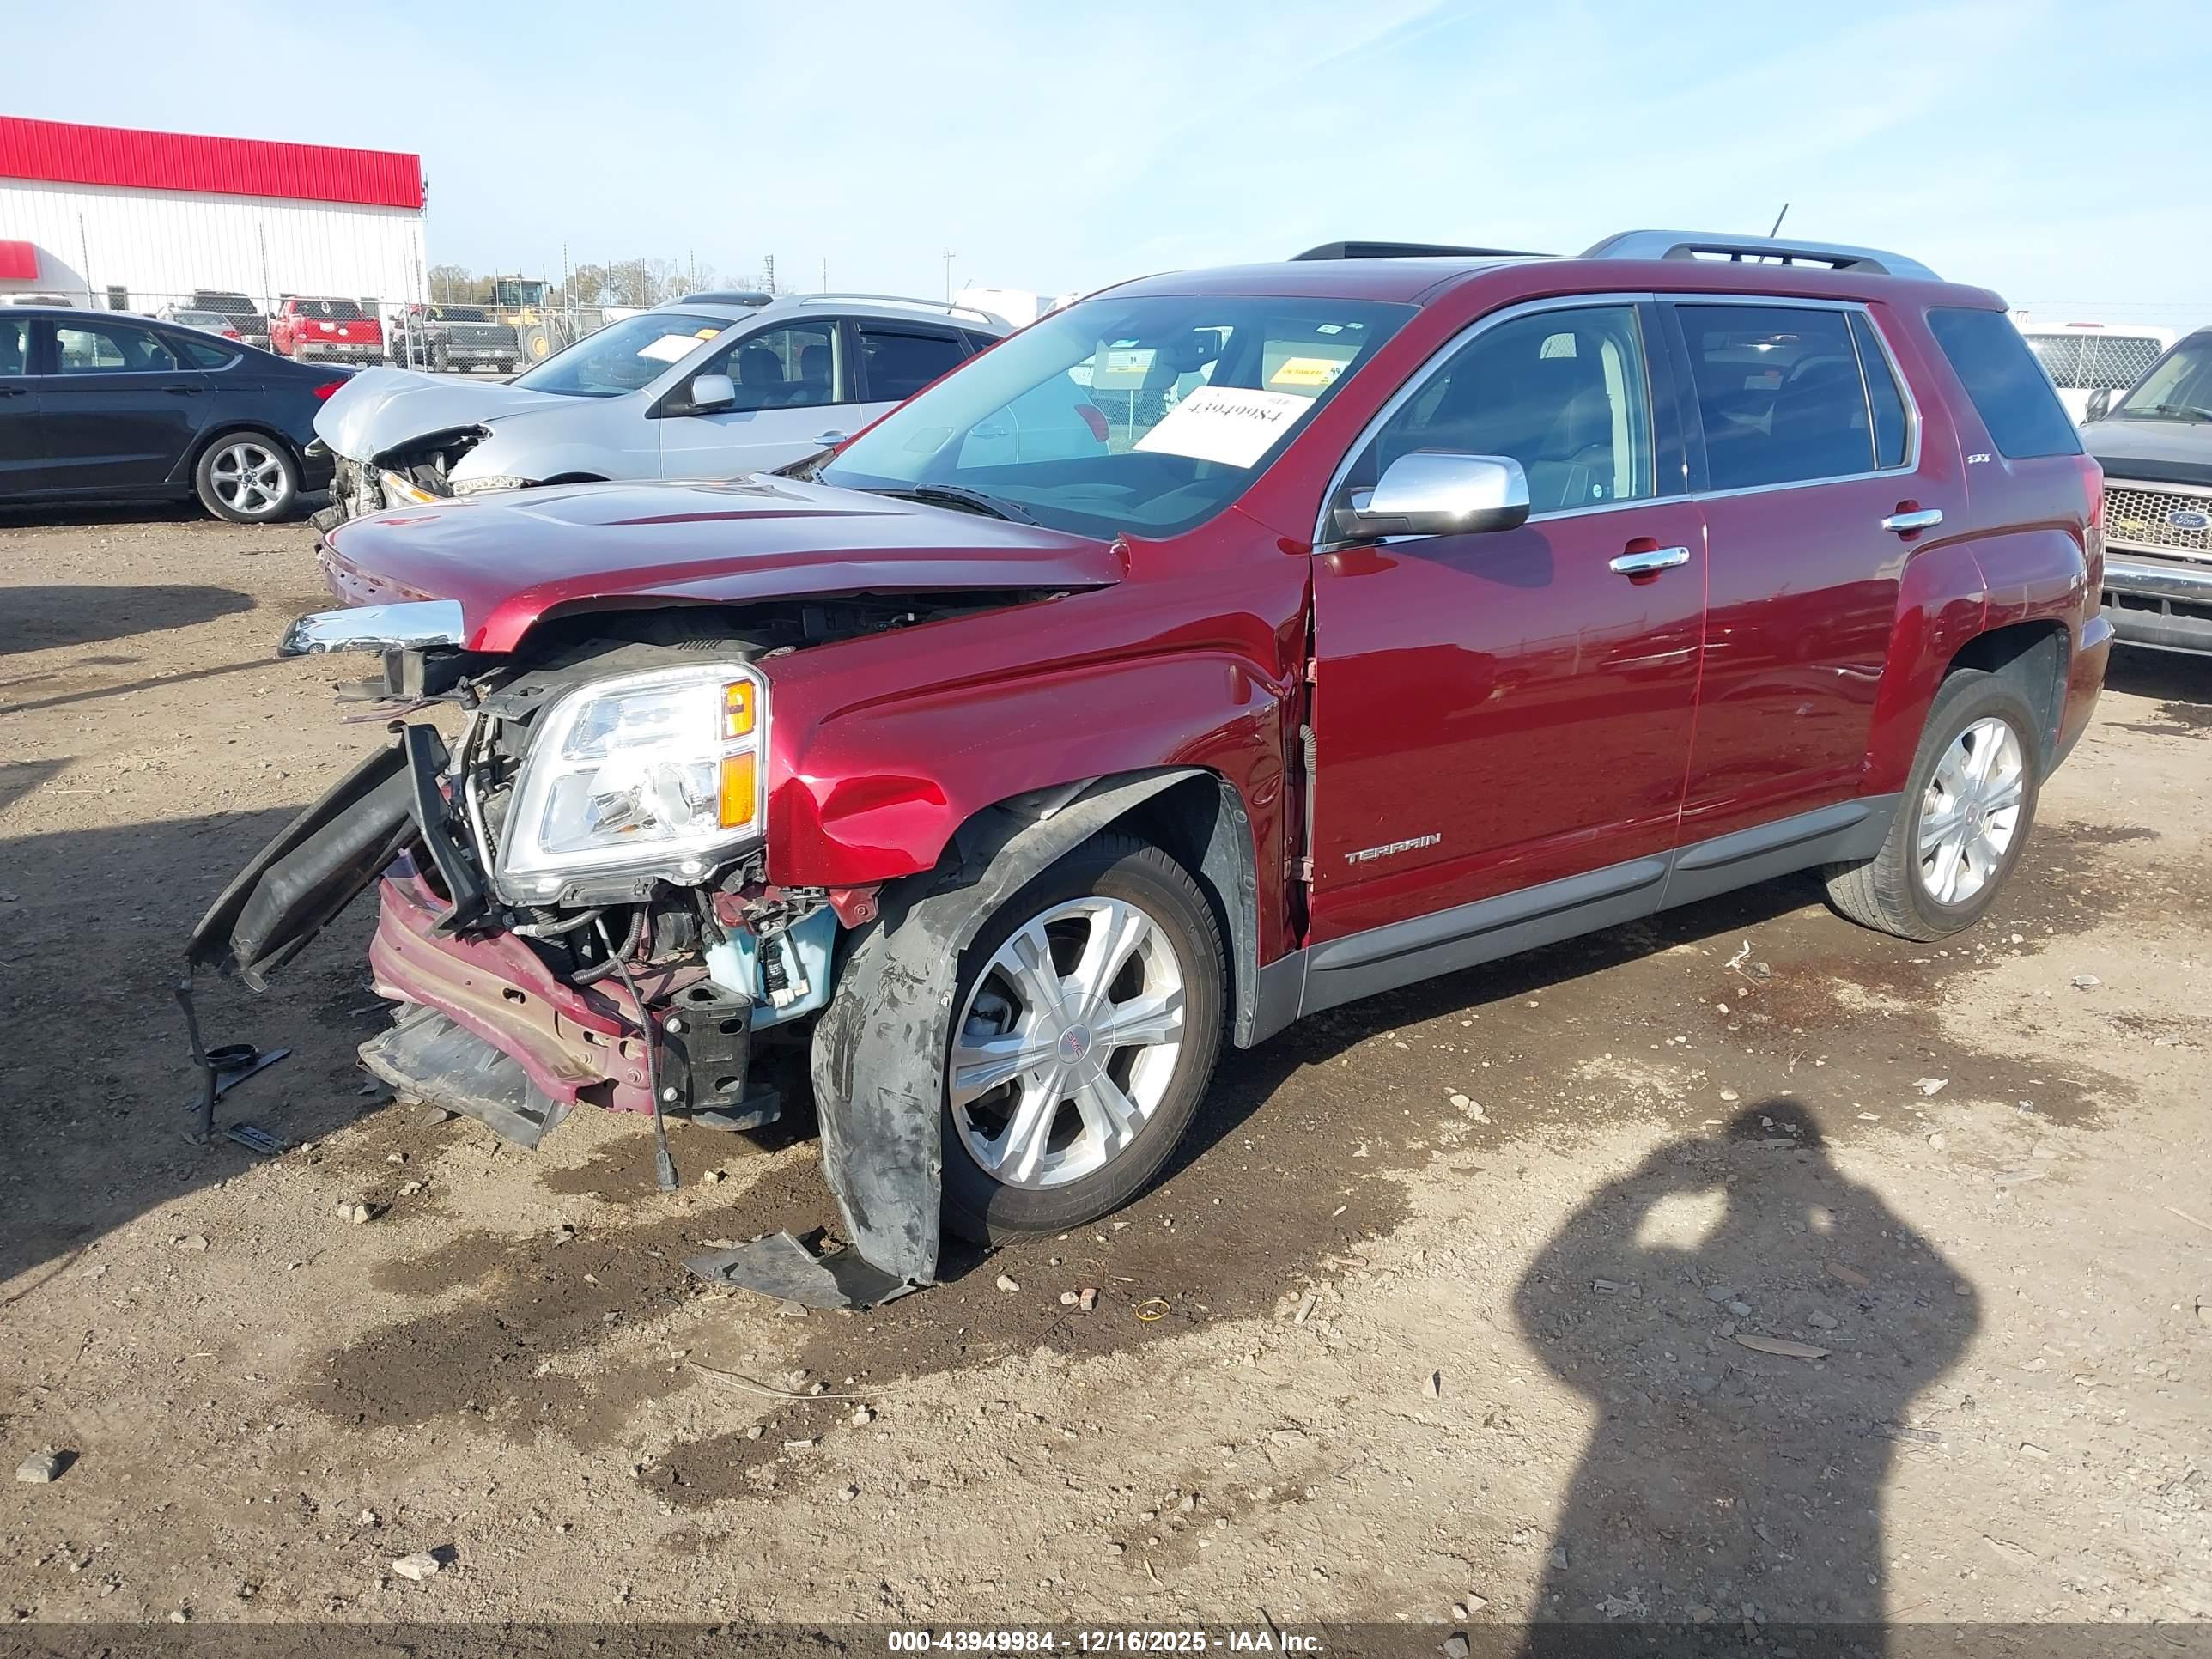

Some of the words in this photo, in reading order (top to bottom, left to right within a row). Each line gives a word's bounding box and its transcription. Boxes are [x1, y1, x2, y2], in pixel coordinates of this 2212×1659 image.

[2175, 514, 2203, 526] Ford
[1344, 832, 1442, 866] TERRAIN
[1066, 1030, 1084, 1059] GMC
